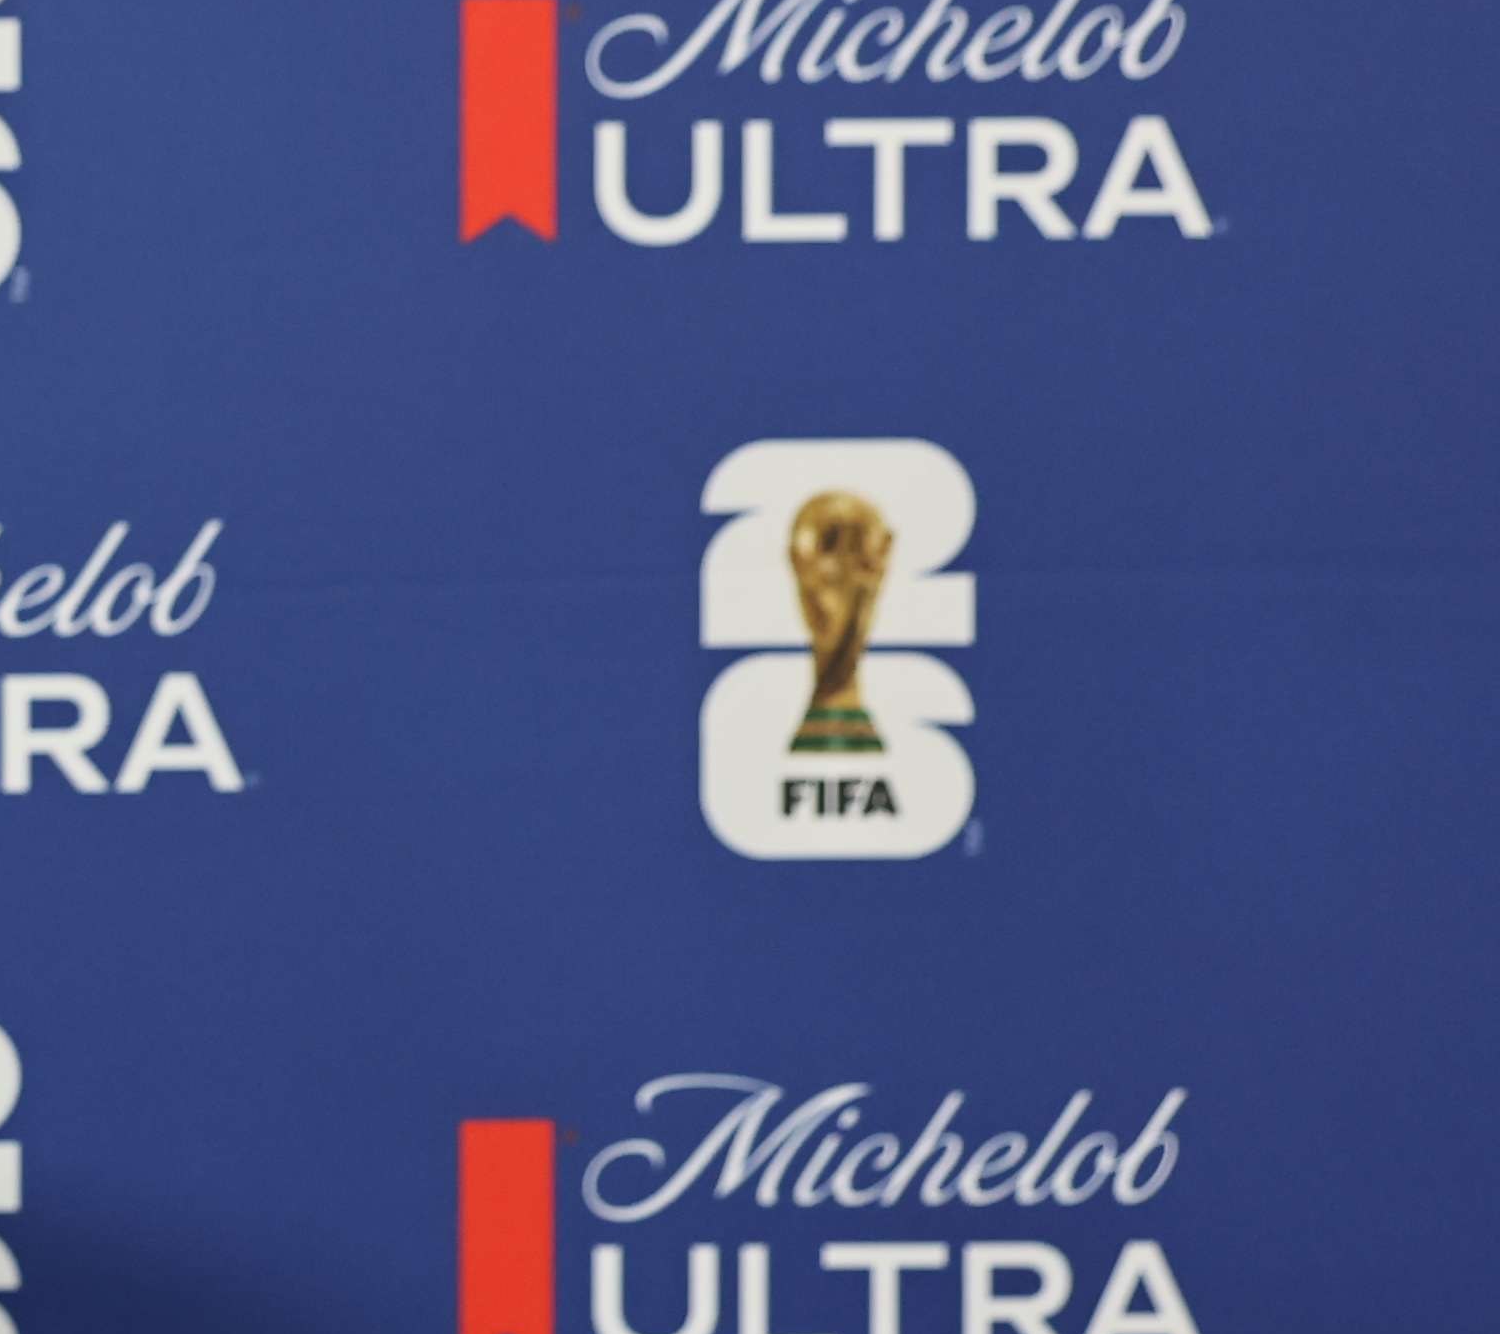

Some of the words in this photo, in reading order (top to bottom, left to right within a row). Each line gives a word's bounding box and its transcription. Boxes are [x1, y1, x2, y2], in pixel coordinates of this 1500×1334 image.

[592, 114, 1215, 248] ULTRA
[781, 777, 898, 818] FIFA
[581, 1072, 1187, 1224] Michelob
